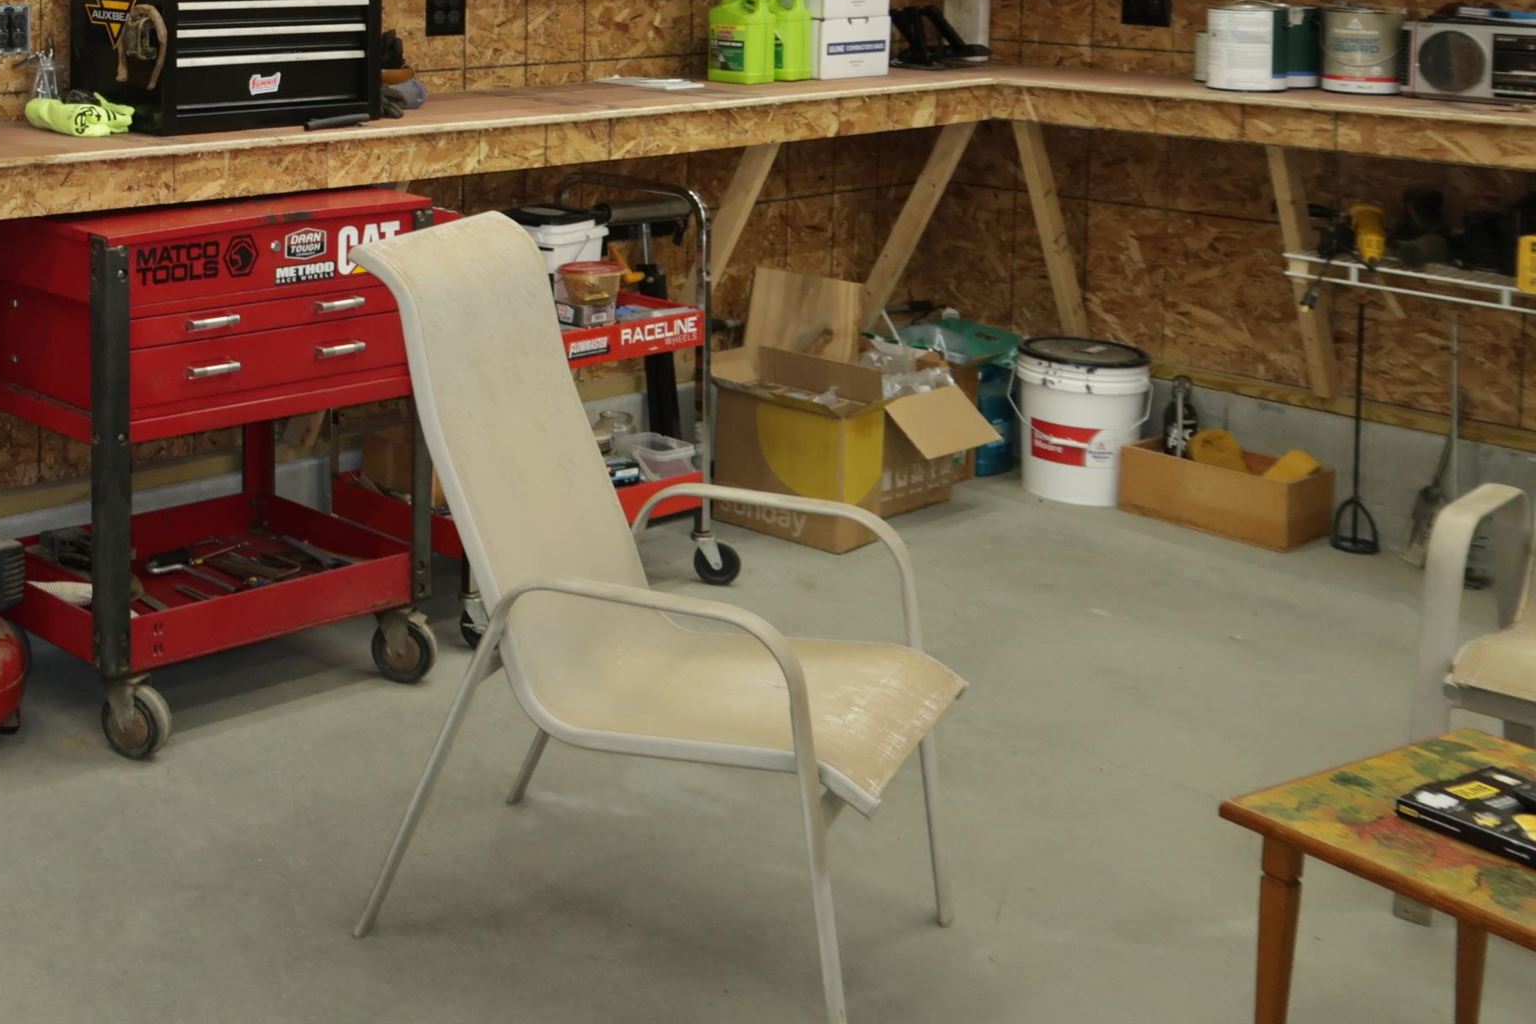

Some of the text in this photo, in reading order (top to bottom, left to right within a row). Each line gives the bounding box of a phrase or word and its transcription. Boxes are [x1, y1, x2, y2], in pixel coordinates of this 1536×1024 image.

[290, 232, 321, 245] DARN
[136, 241, 219, 266] MATCO
[290, 243, 321, 254] TOUGH
[137, 260, 219, 286] TOOLS
[276, 261, 334, 279] METHOD
[621, 317, 698, 346] RACELINE
[664, 333, 697, 345] WHEELS
